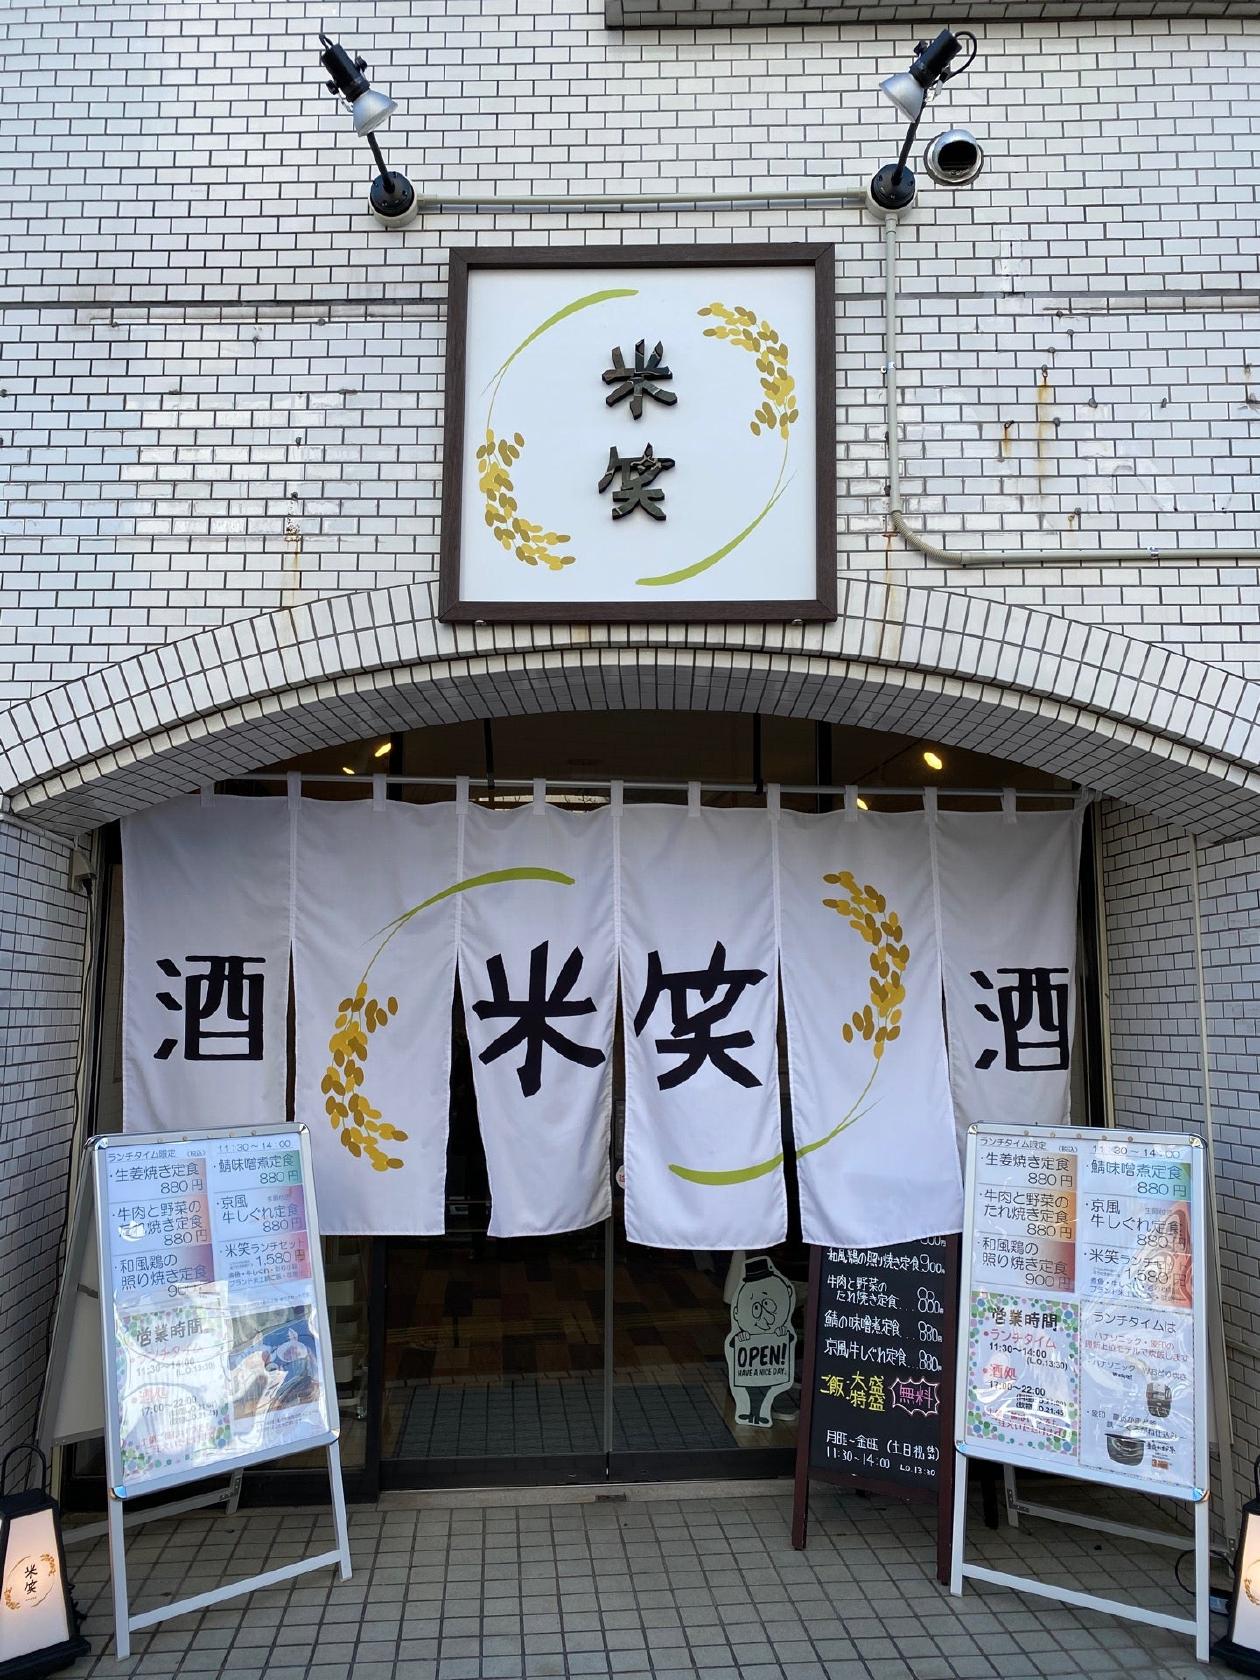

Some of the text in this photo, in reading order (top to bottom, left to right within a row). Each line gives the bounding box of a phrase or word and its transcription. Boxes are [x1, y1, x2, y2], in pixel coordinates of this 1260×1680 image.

[598, 338, 678, 520] 米笑
[154, 940, 1070, 1096] 酒 米笑 酒
[980, 1137, 1047, 1150] ランチタイム限定
[108, 1149, 176, 1162] ランチタイム限定
[160, 1179, 203, 1194] 880円
[259, 1169, 299, 1185] 880円
[1027, 1172, 1073, 1188] 880円
[1136, 1181, 1187, 1198] 880円
[222, 1203, 298, 1224] 牛しぐれ定食
[984, 1204, 1069, 1225] たれ焼き定食
[1090, 1198, 1121, 1215] 京風
[262, 1217, 302, 1233] 880円
[1026, 1223, 1072, 1240] 880円
[164, 1229, 208, 1246] 880円
[982, 1252, 1068, 1276] 照り焼き定食
[121, 1264, 208, 1291] 照り焼き定食
[1025, 1272, 1071, 1290] 900円
[991, 1307, 1058, 1332] 営業時間
[1093, 1311, 1177, 1334] ランチタイムは
[136, 1319, 204, 1348] 営業時間
[990, 1328, 1057, 1350] ランチタイム
[737, 1342, 788, 1368] OPEN!
[989, 1341, 1047, 1359] 11:30~14:00
[738, 1368, 753, 1377] HAVE
[753, 1368, 759, 1376] A
[759, 1368, 772, 1376] NICE
[899, 1384, 934, 1409] 無料
[24, 1563, 38, 1595] 米笑
